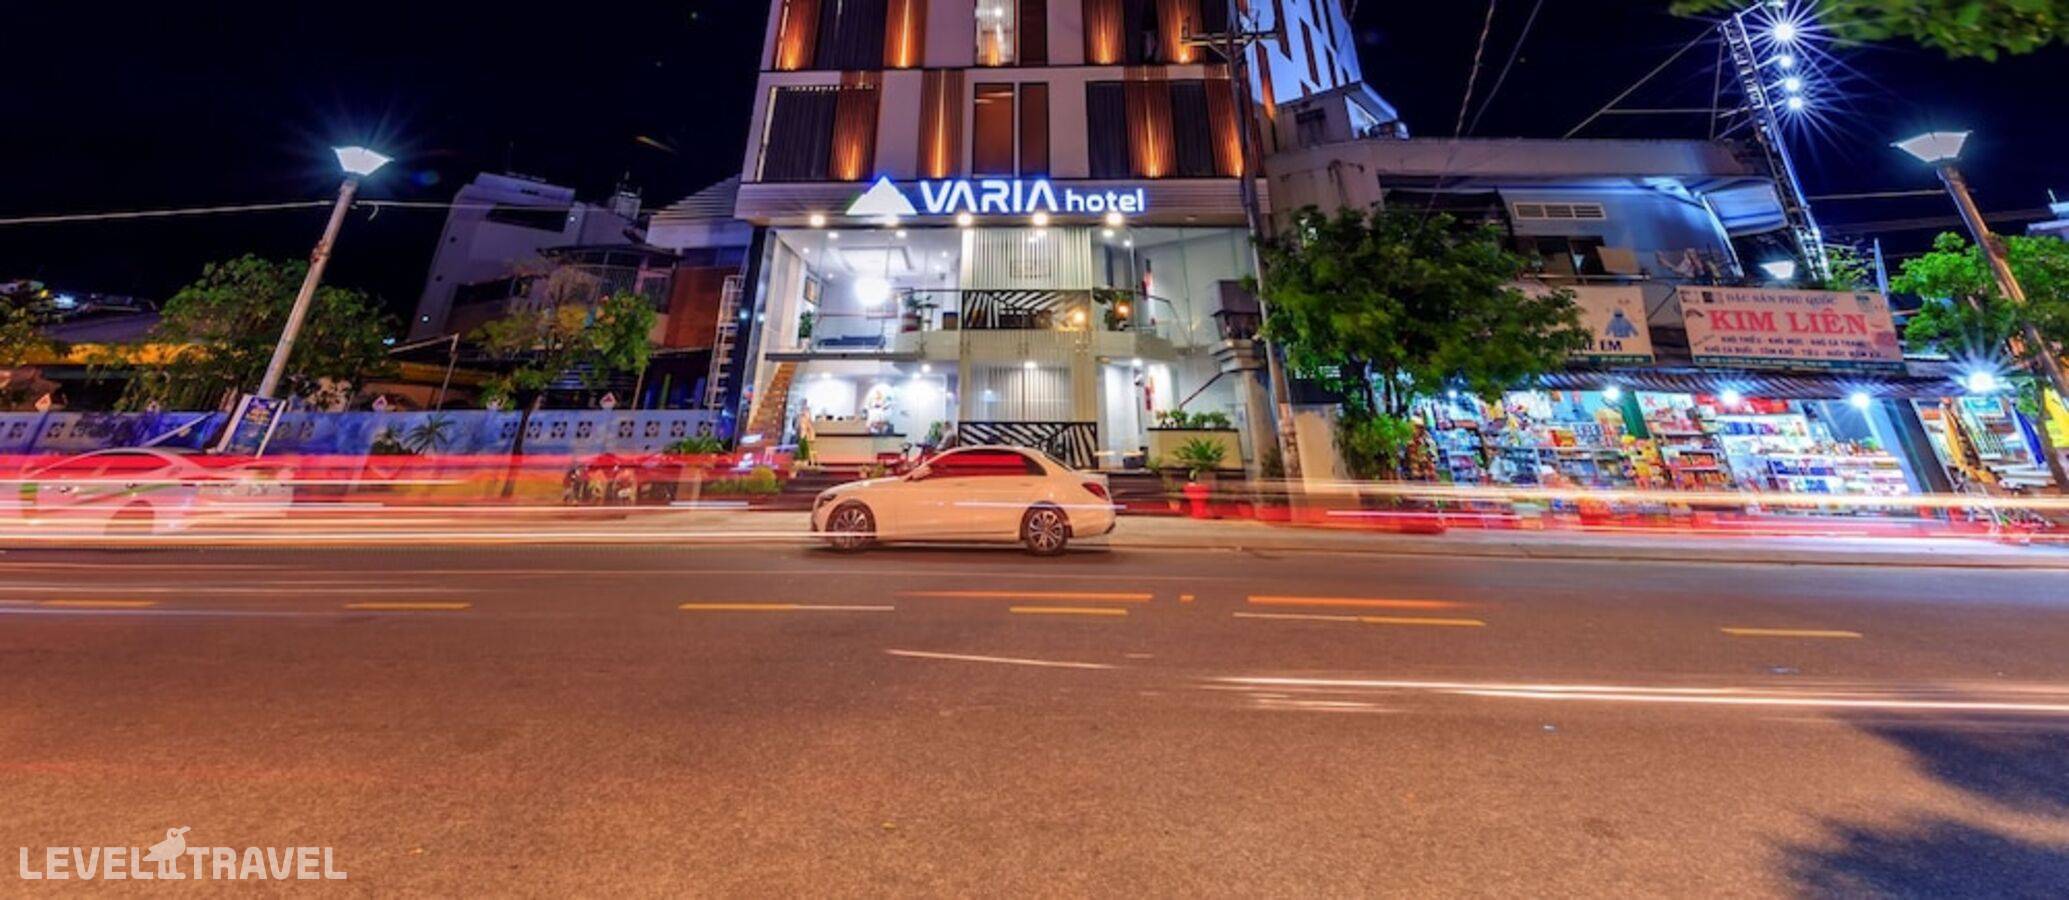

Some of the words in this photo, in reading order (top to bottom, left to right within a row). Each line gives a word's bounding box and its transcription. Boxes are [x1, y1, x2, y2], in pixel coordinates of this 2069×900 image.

[920, 179, 1059, 213] VARIA
[1065, 188, 1144, 212] hotel
[1707, 309, 1777, 332] KIM
[1785, 308, 1868, 334] LIÊN
